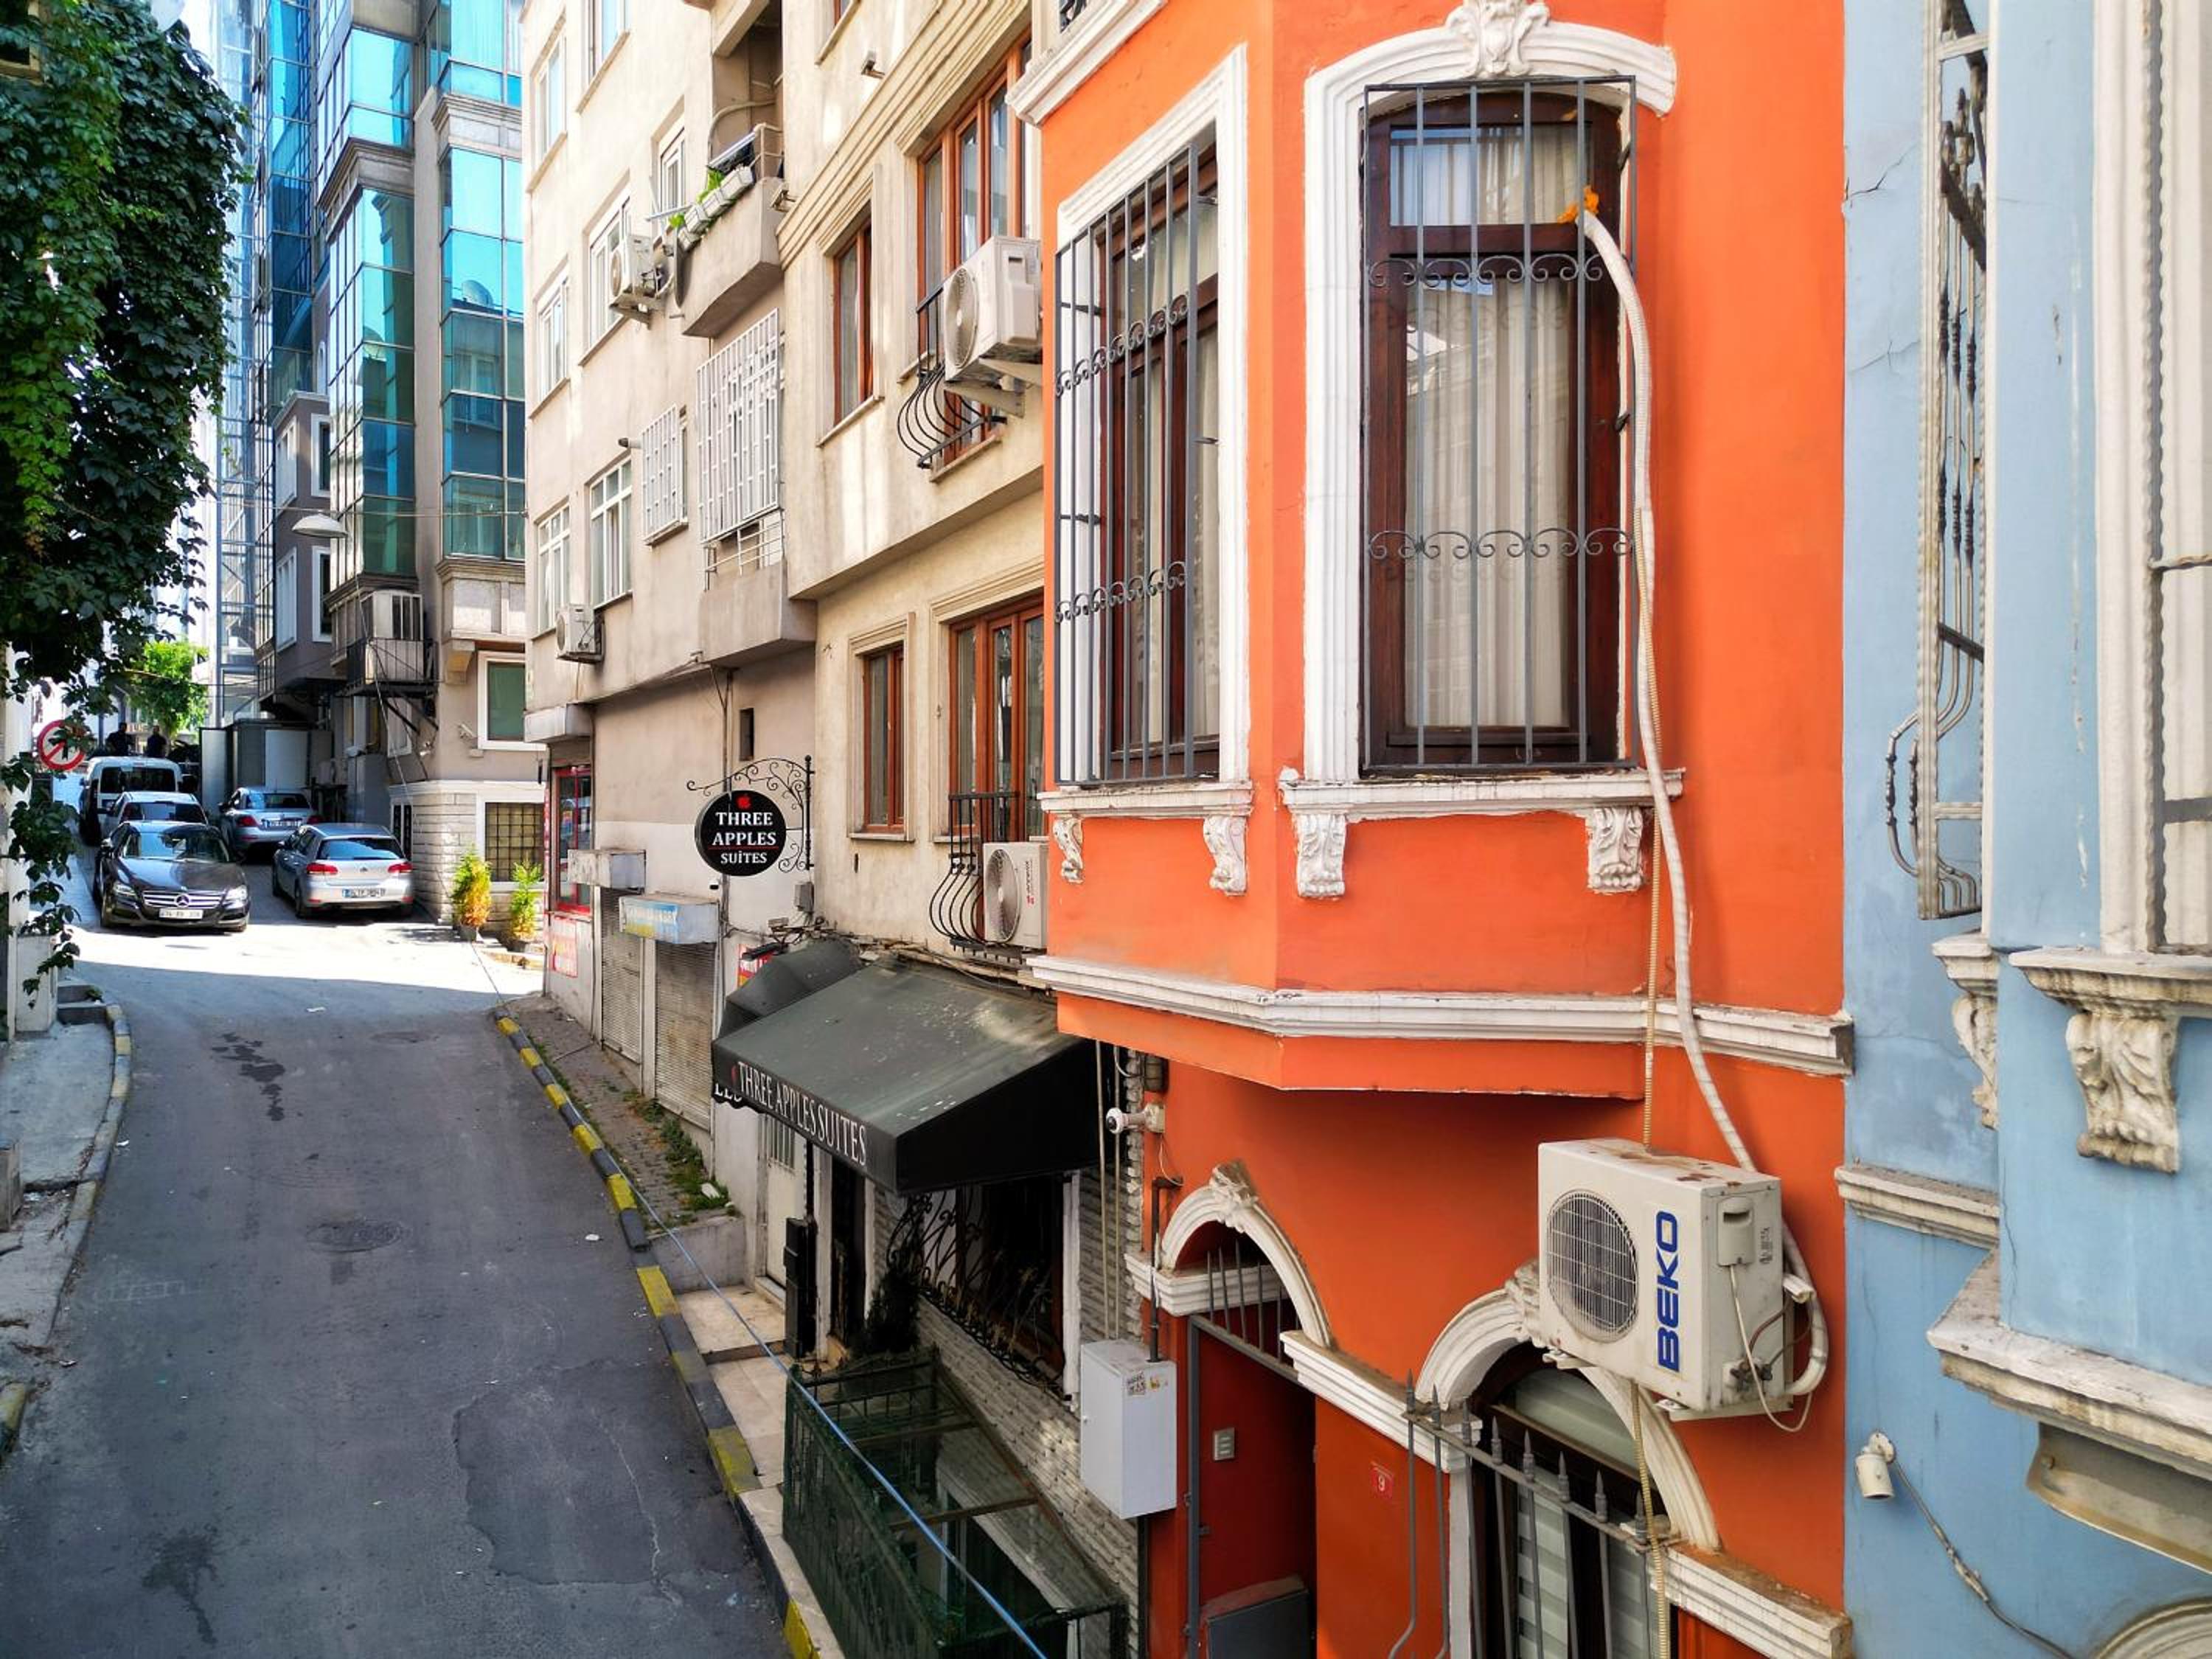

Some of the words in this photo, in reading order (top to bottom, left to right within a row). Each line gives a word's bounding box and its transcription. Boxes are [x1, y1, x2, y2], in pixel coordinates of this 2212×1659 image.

[712, 832, 776, 846] APPLES
[715, 813, 773, 825] THREE
[738, 1061, 773, 1109] THREE
[775, 1083, 816, 1135] APPLES
[818, 1104, 866, 1166] SUITES
[1656, 1211, 1680, 1372] BEKO
